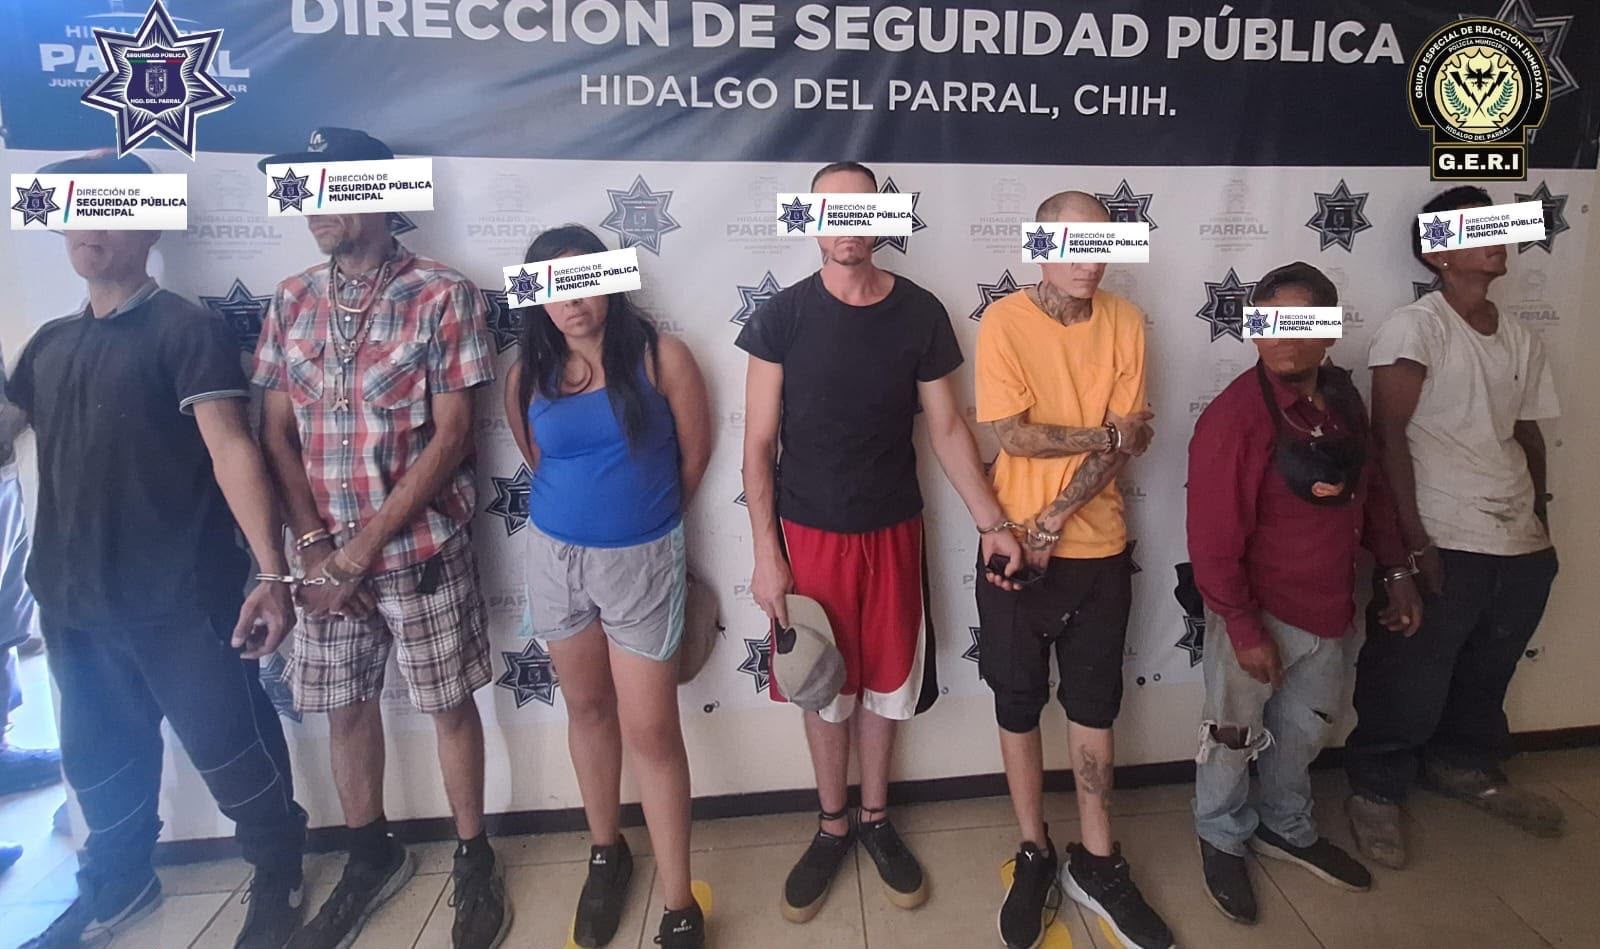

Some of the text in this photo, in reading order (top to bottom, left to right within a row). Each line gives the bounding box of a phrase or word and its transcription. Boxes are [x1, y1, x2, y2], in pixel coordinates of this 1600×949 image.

[692, 3, 776, 48] DE
[794, 5, 1150, 58] SEGURIDAD
[1166, 5, 1405, 65] PÚBLICA
[580, 74, 1177, 119] HIDALGO DEL PARRAL, CHIH.
[188, 224, 282, 238] PARRAL
[467, 224, 541, 237] PARRA
[1199, 223, 1269, 235] PARRAL
